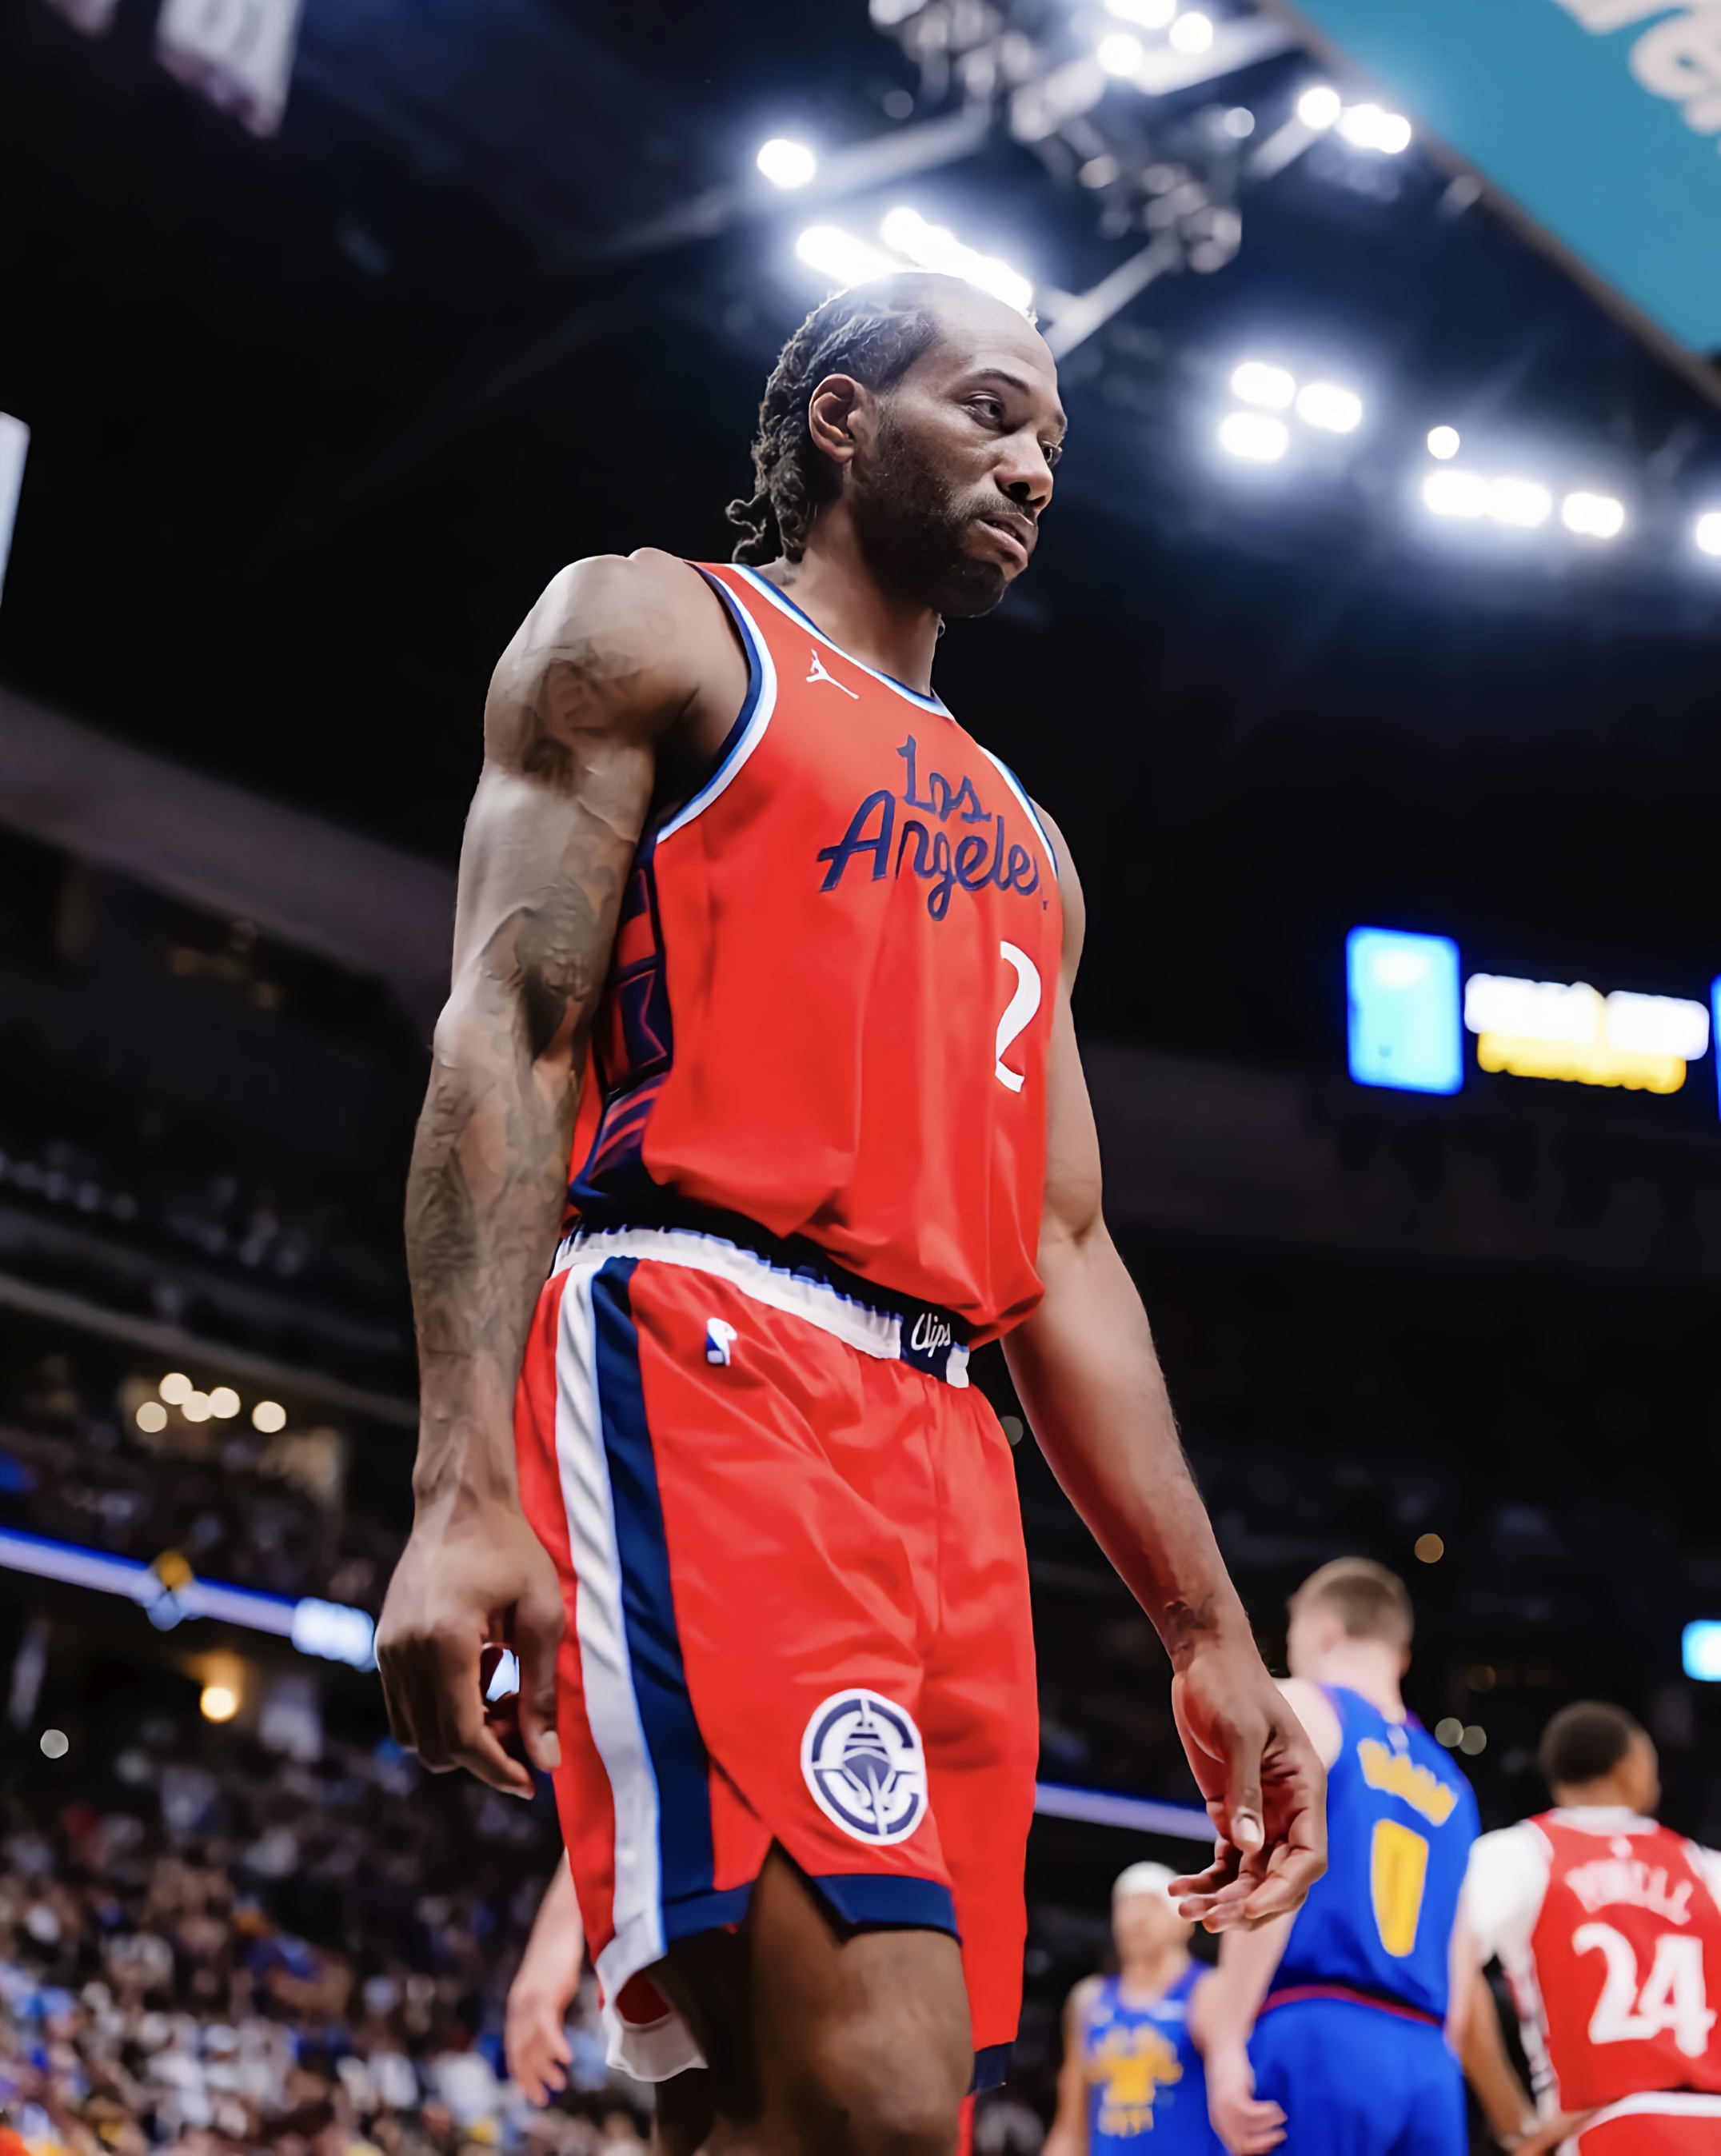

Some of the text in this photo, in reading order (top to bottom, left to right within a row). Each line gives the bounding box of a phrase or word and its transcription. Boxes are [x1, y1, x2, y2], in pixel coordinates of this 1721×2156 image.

[896, 734, 992, 823] Los
[995, 940, 1042, 1093] 2
[1370, 1818, 1430, 1958] 0
[1571, 1922, 1718, 2058] 24
